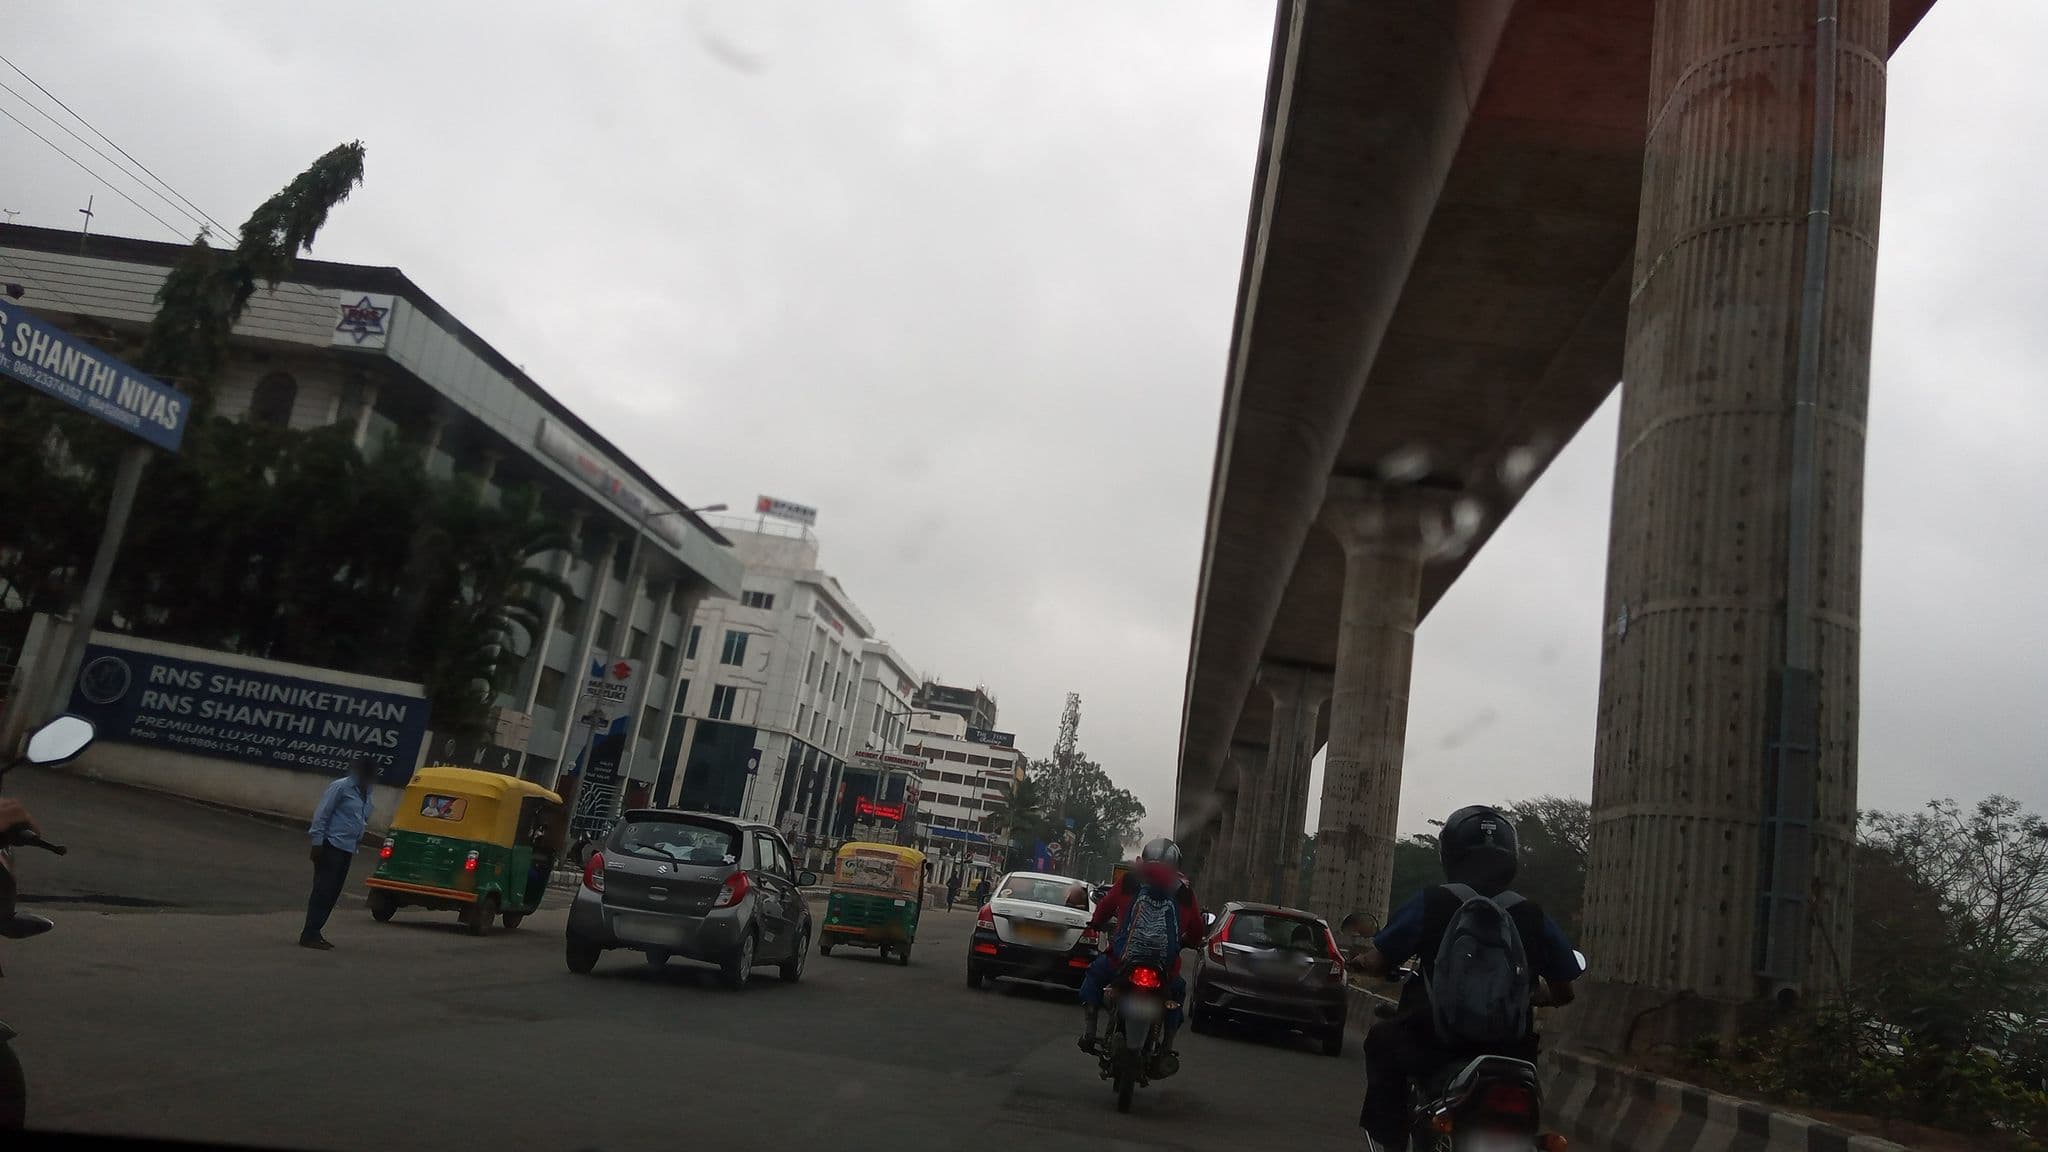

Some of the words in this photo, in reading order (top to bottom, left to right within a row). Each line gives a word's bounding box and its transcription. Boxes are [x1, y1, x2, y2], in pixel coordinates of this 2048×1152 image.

[12, 322, 117, 399] SHANTHI
[117, 376, 181, 430] NIVAS
[140, 690, 195, 715] RNS
[199, 700, 316, 735] SHANTHI
[322, 719, 401, 749] NIVAS
[149, 664, 204, 690] RNS
[208, 674, 408, 723] SHRINIKETHAN
[135, 715, 215, 736] PREMIUM
[218, 728, 286, 747] LUXURY
